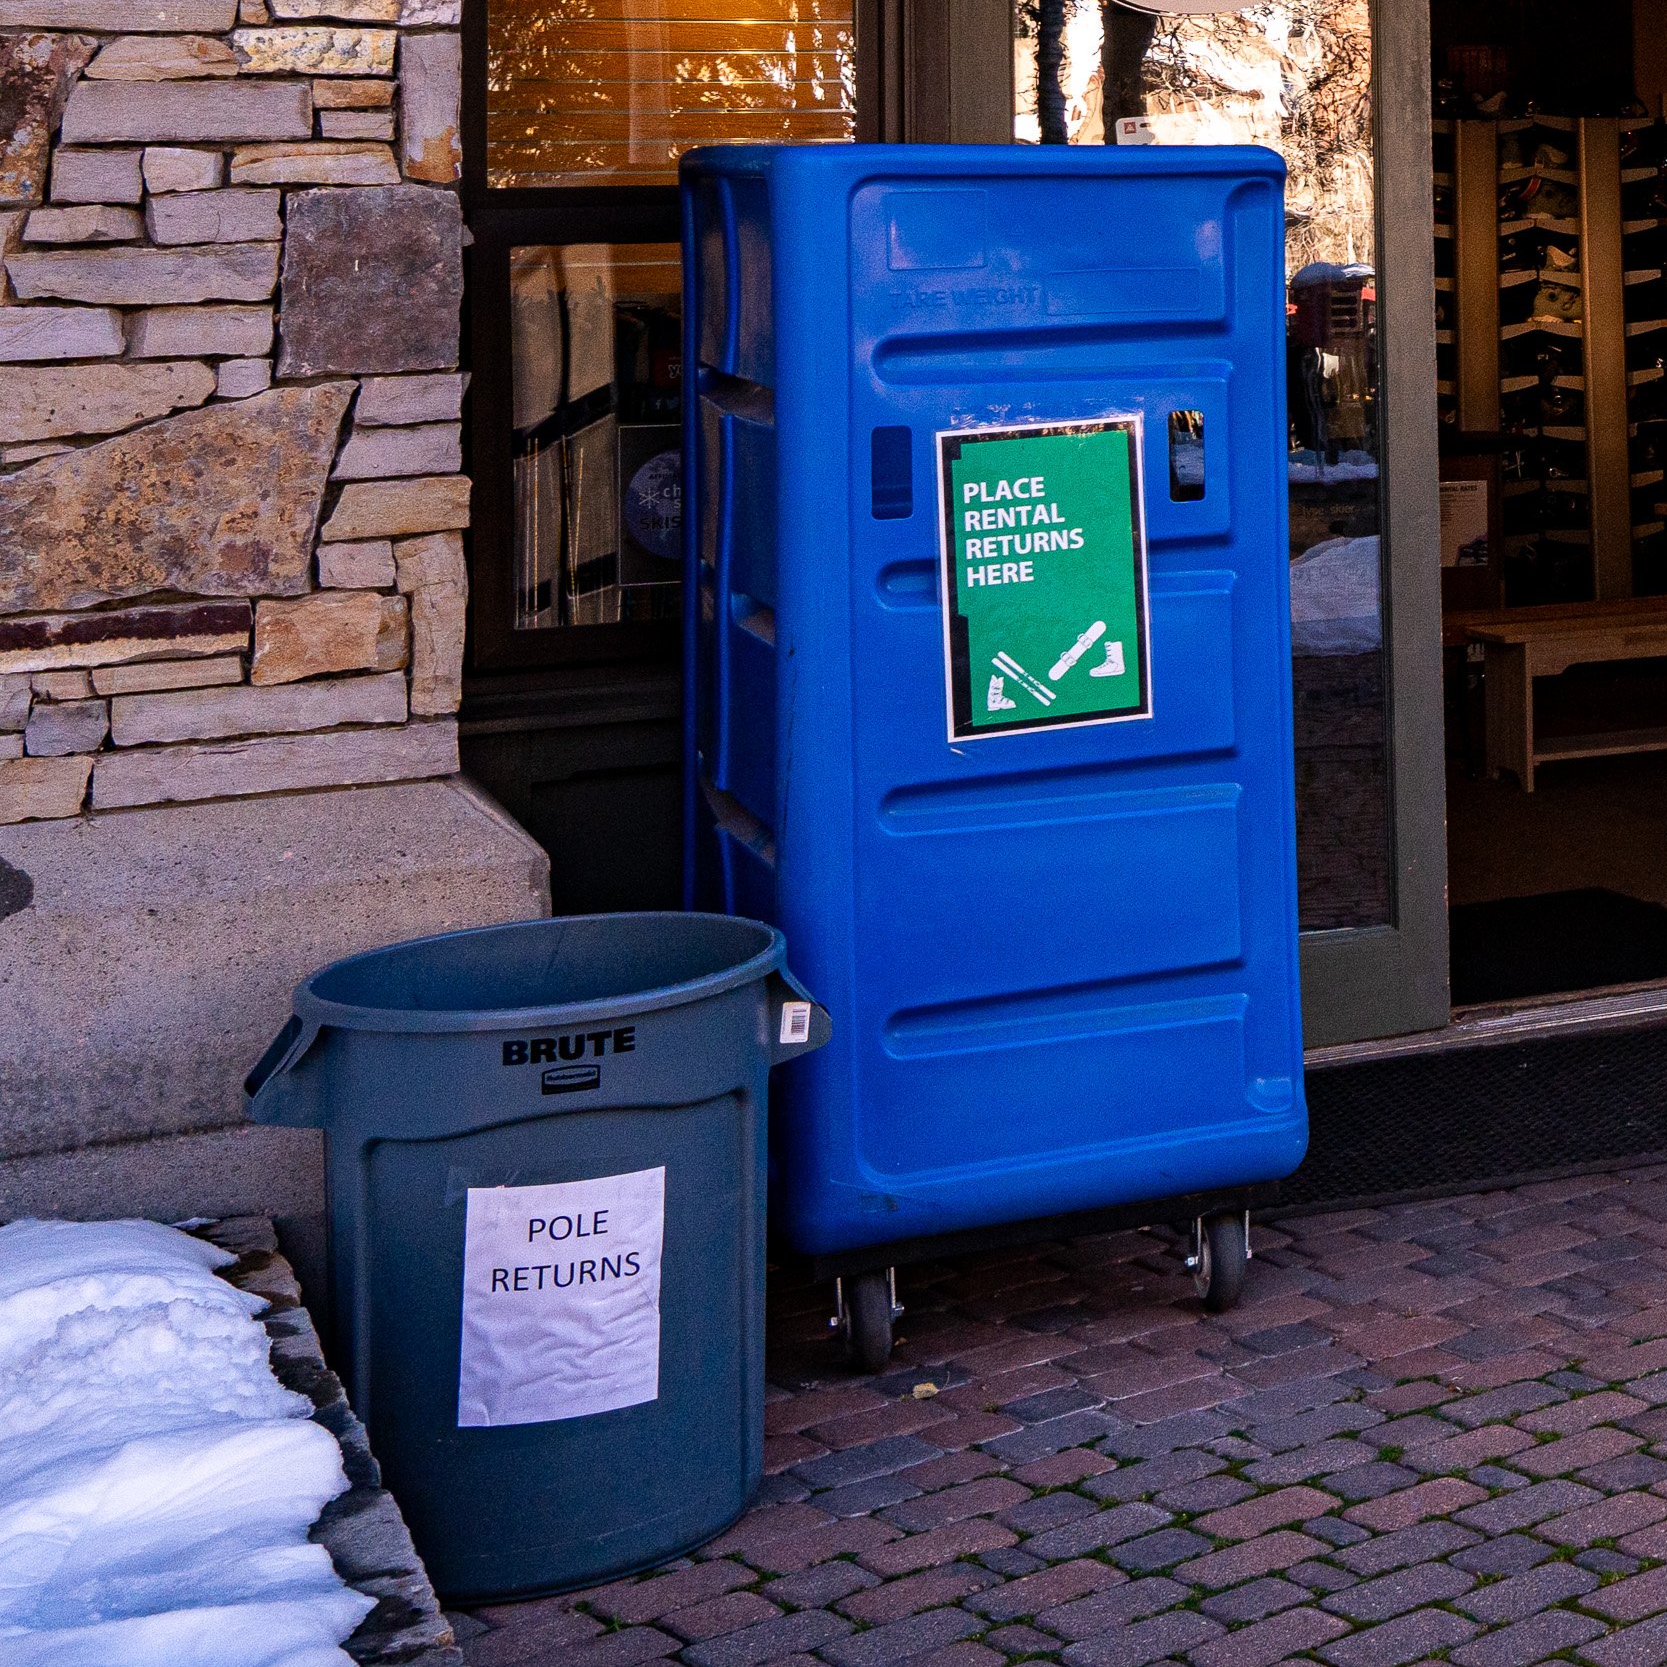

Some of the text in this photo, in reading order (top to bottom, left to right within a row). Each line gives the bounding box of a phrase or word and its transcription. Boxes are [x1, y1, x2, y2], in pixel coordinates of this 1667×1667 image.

[963, 476, 1046, 504] PLACE
[964, 503, 1065, 531] RENTAL
[965, 528, 1085, 559] RETURNS
[967, 561, 1035, 588] HERE
[502, 1026, 636, 1066] BRUTE
[528, 1210, 609, 1242] POLE
[491, 1251, 641, 1293] RETURNS
